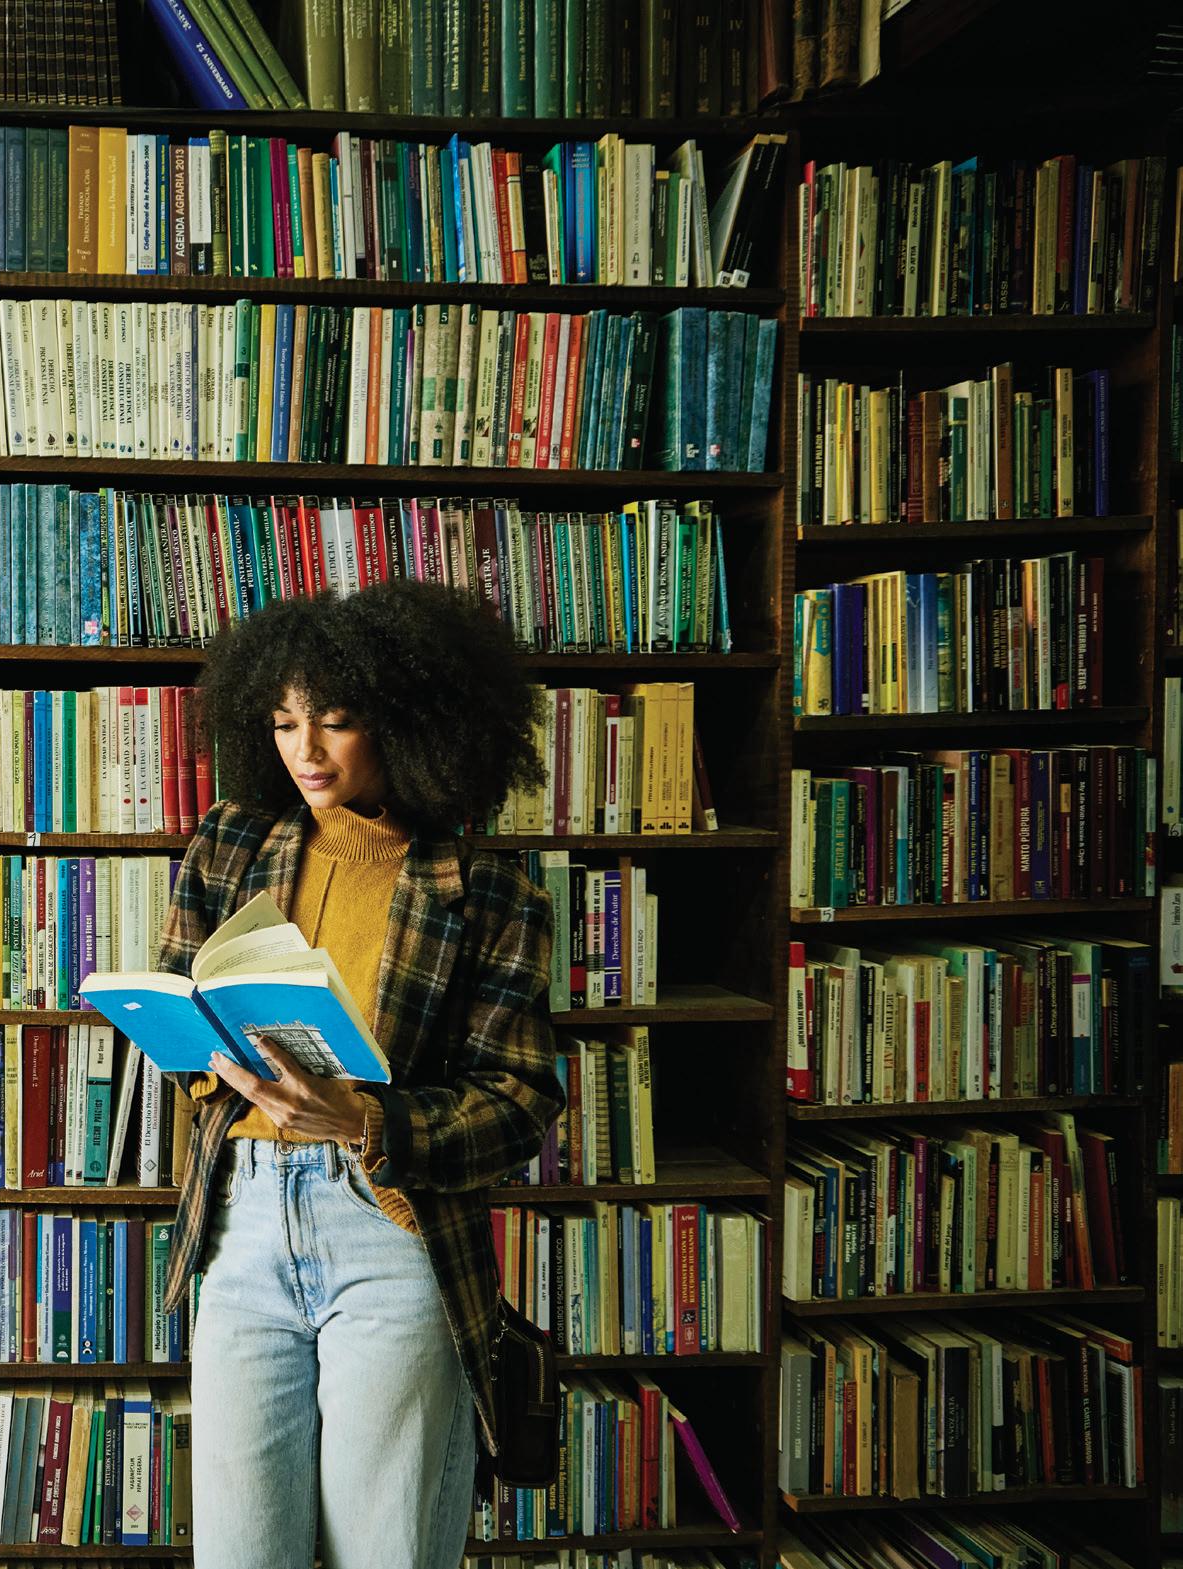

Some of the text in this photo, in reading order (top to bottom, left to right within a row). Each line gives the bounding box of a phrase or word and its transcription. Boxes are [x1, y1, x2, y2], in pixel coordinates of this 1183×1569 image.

[196, 42, 234, 99] 75 ANIVERSARIO
[175, 149, 185, 256] AGENDA AGRARIA 2013
[815, 434, 824, 460] PALACIO
[815, 466, 823, 488] ASALTO
[212, 532, 222, 569] EXCLUSIÓN
[234, 519, 246, 584] INTERNACIONAL
[262, 511, 277, 599] DERECHO PROCESAL FAMILIAR
[388, 516, 400, 563] MERCANTIL
[160, 522, 176, 618] INVERSIÓN EXTRANJERA
[244, 553, 254, 588] PÚBLICO
[327, 538, 339, 580] JUDICIAL
[481, 548, 494, 601] ARBITRAJE
[658, 515, 668, 635] EL AMPARO PENAL INDIRECTO
[216, 576, 226, 609] DIGNIDAD
[1078, 614, 1087, 623] LA
[1078, 624, 1087, 652] GUERRA
[1078, 669, 1087, 690] ZETAS
[835, 828, 846, 840] DE
[1020, 807, 1031, 872] MANTO PÚRPURA
[835, 841, 846, 880] JEFATURA
[611, 927, 619, 960] Derechos
[146, 1065, 154, 1084] juicio
[145, 1090, 153, 1108] Penal
[144, 1110, 152, 1138] Derecho
[26, 1169, 45, 1178] Ariel
[556, 1238, 564, 1264] MÉXICO
[154, 1264, 162, 1295] Gobierno:
[680, 1240, 688, 1303] ADMINISTRACIÓN
[154, 1296, 162, 1313] Buen
[556, 1275, 564, 1304] FISCALES
[154, 1319, 162, 1350] Municipio
[556, 1306, 564, 1331] DELITOS
